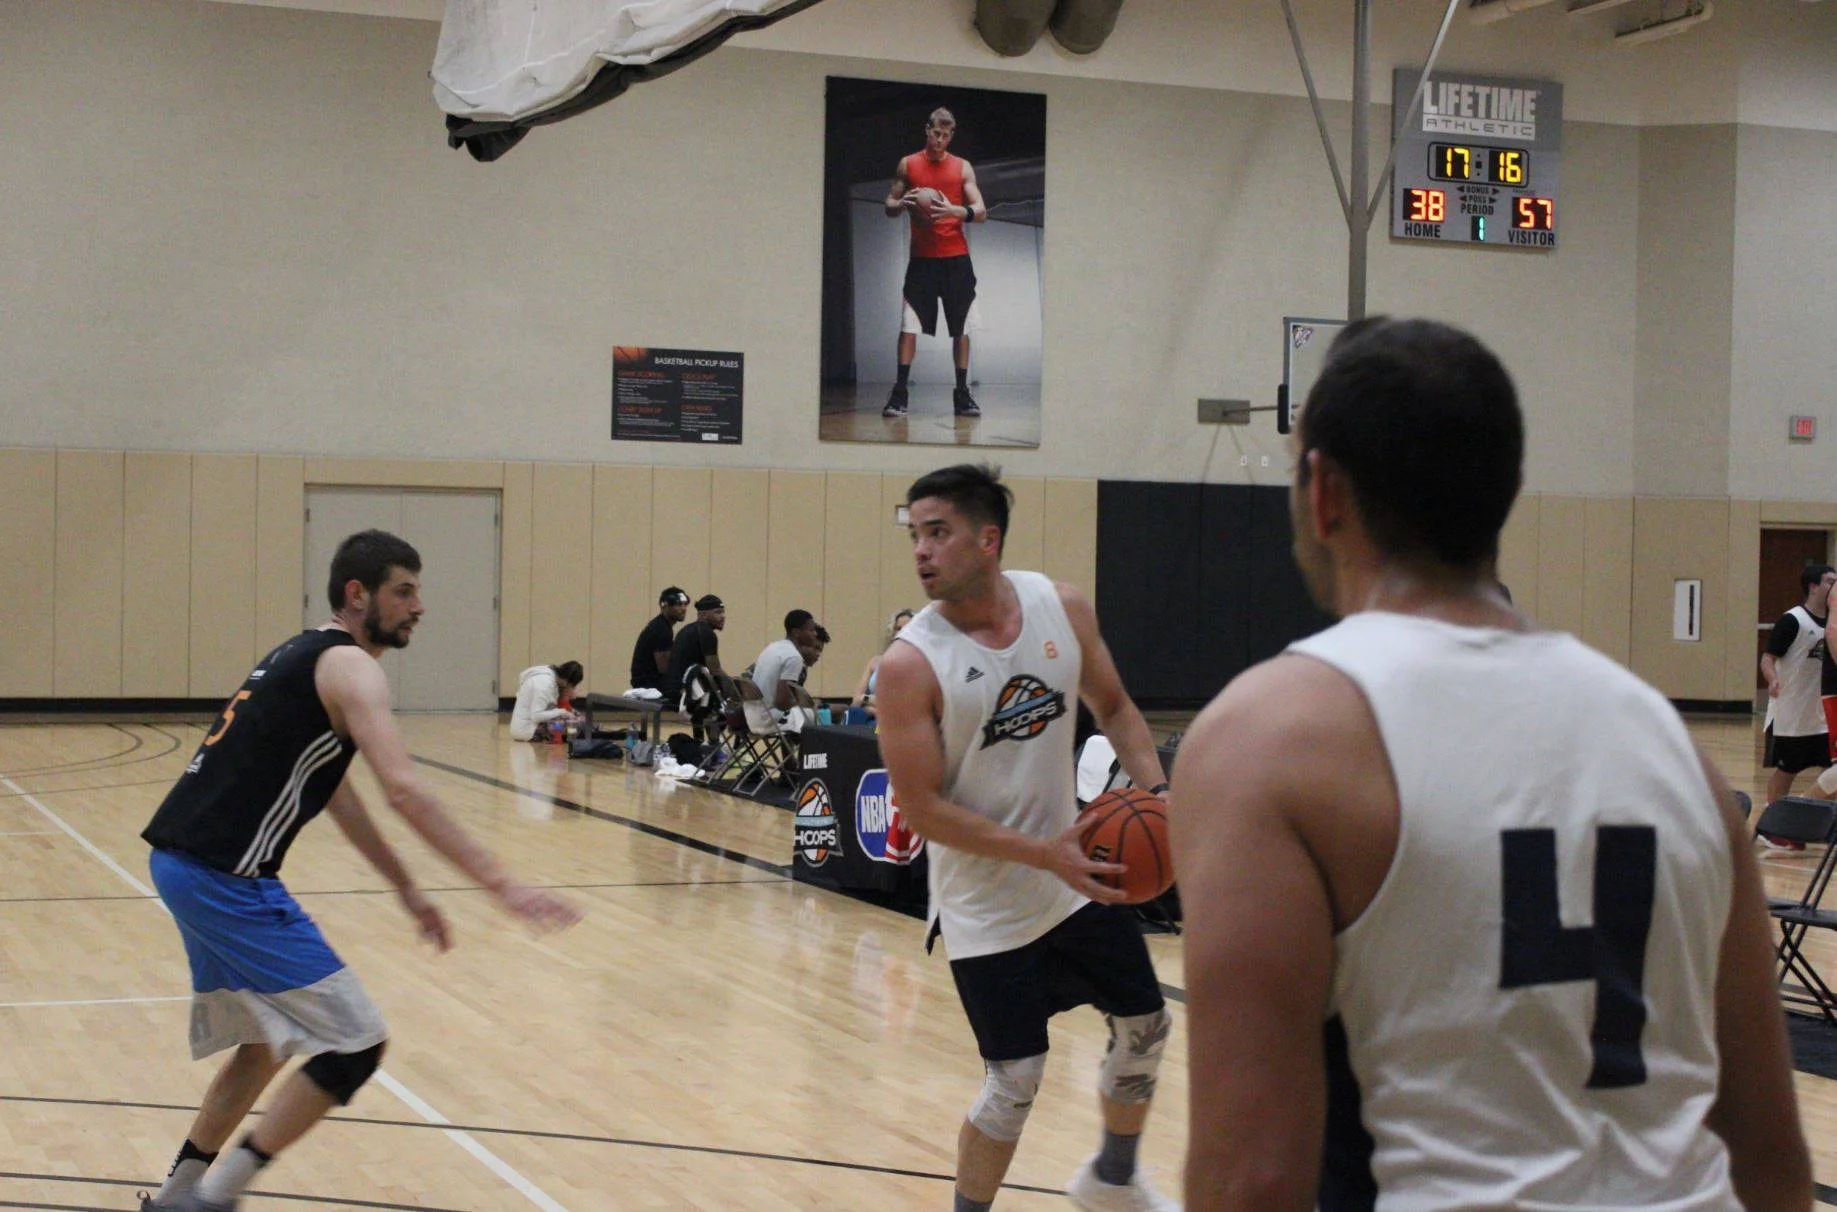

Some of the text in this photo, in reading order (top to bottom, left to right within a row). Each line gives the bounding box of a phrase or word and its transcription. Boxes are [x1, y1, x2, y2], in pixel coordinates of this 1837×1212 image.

[1423, 81, 1537, 123] LIFETIME
[1426, 117, 1533, 136] ATHLETIC
[1446, 147, 1523, 183] 17 16
[1411, 189, 1444, 221] 38
[1461, 204, 1494, 215] PERIOD
[1519, 198, 1552, 229] 57
[1405, 222, 1441, 238] HOME
[1508, 230, 1555, 246] VISITOR
[654, 357, 693, 366] BASKETBALL
[695, 359, 718, 367] PICKUP
[994, 701, 1057, 735] HOOPS
[803, 753, 828, 770] LIFETIME
[861, 795, 886, 833] NBA
[1499, 825, 1656, 1089] 4
